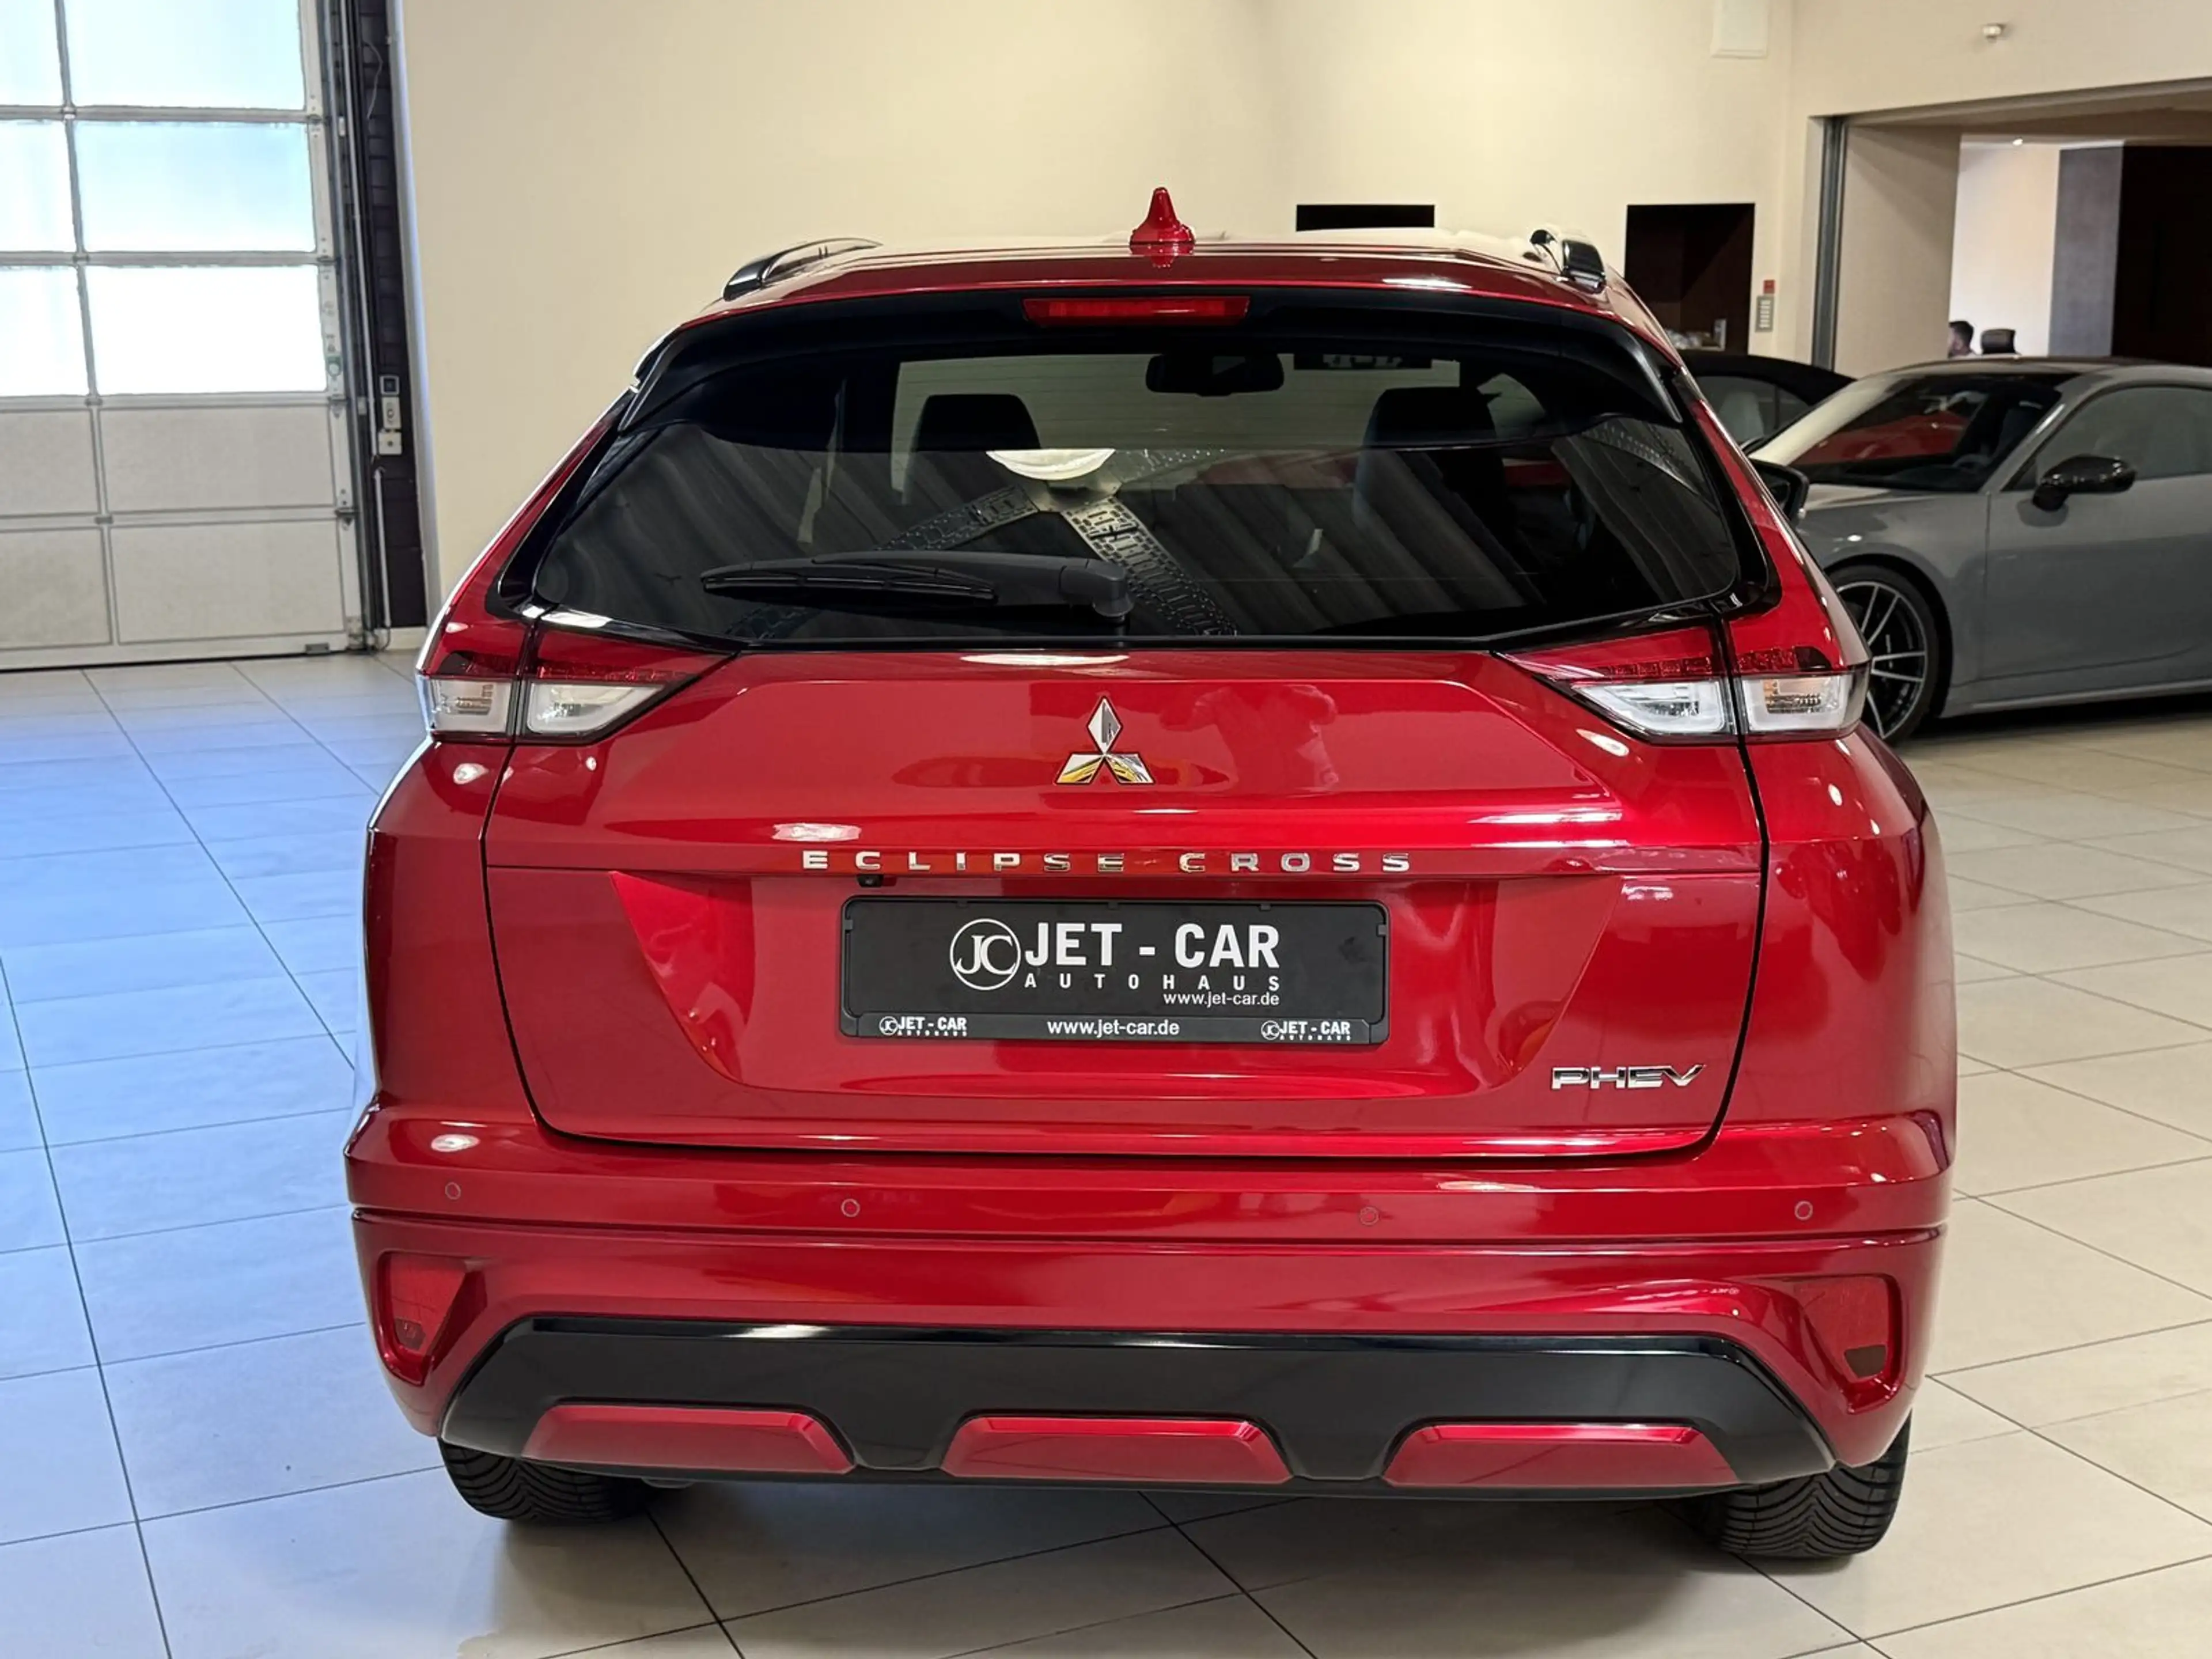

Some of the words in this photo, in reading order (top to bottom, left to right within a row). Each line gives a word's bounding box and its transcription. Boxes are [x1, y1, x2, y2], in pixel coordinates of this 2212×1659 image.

[802, 851, 1124, 872] ECLIPSE
[1179, 852, 1410, 873] CROSS
[1024, 922, 1123, 967] JET
[1175, 923, 1280, 968] CAR
[1024, 973, 1279, 991] AUTOHAUS
[1162, 991, 1280, 1007] www.jet-car.de
[897, 1016, 925, 1030] JET
[937, 1016, 967, 1031] CAR
[1047, 1019, 1180, 1038] www.jet-car.de
[1280, 1021, 1308, 1034] JET
[1320, 1021, 1351, 1035] CAR
[1551, 1065, 1706, 1090] PHEV
